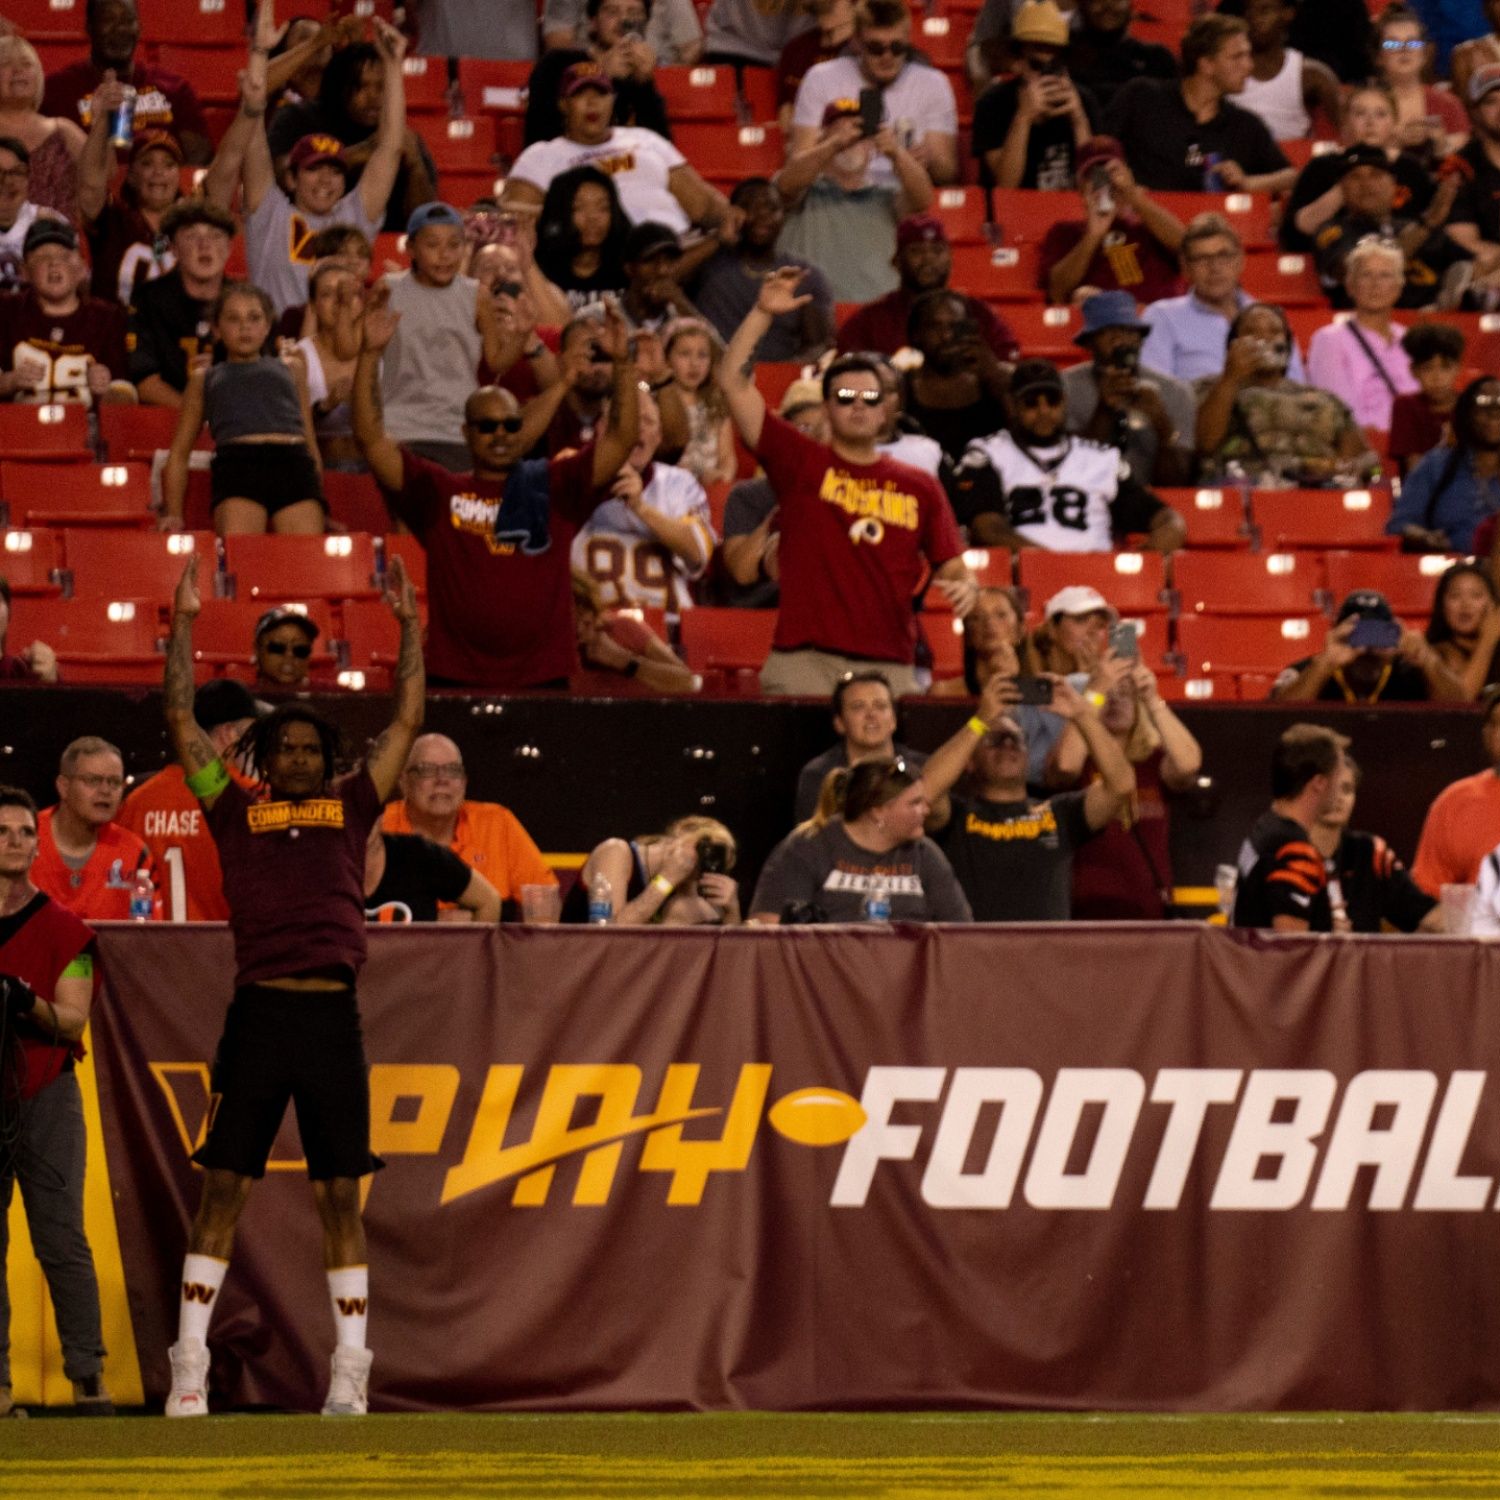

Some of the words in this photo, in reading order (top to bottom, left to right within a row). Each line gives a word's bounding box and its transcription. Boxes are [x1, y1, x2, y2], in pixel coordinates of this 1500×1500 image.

[1009, 486, 1089, 532] 28
[144, 810, 201, 836] CHASE
[248, 801, 344, 830] COMMANDERS
[164, 846, 187, 922] 1
[359, 1063, 773, 1208] PLAY
[183, 1282, 215, 1305] W
[335, 1296, 368, 1315] W
